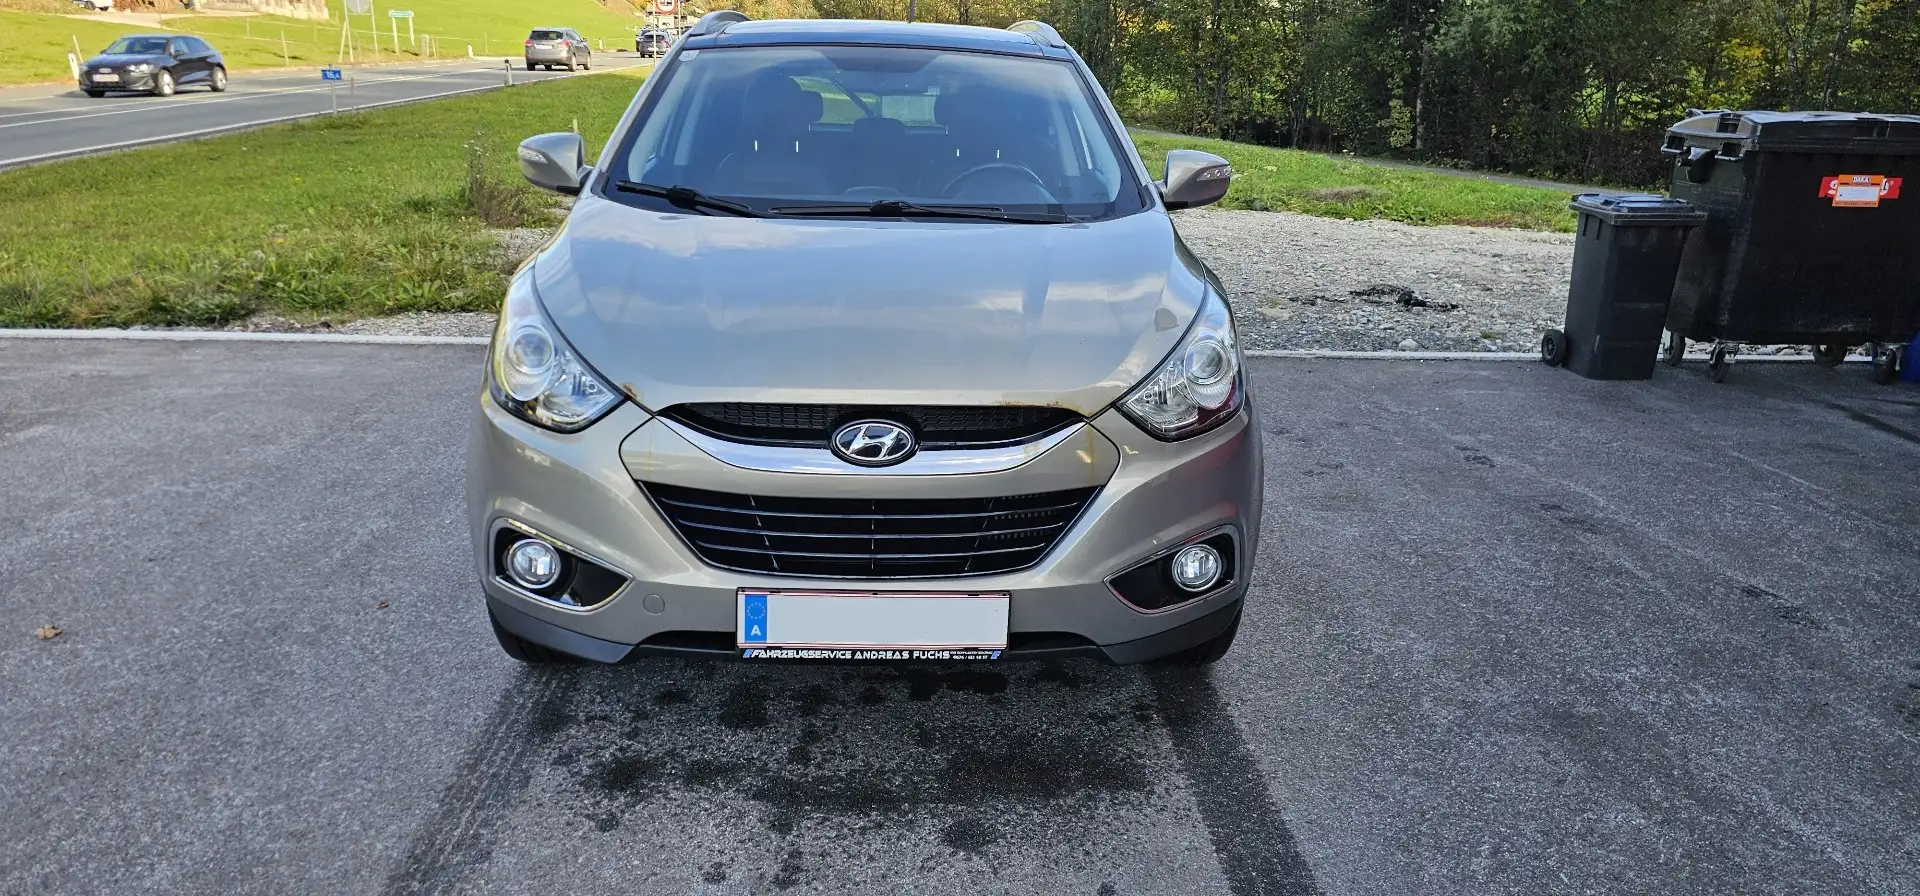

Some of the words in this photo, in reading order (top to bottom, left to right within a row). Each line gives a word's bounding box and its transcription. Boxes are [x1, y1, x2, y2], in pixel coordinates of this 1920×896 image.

[751, 625, 762, 636] A
[751, 649, 852, 660] FAHRZEUGSERVICE
[854, 650, 910, 660] ANDREAS
[913, 650, 950, 660] FUCHS
